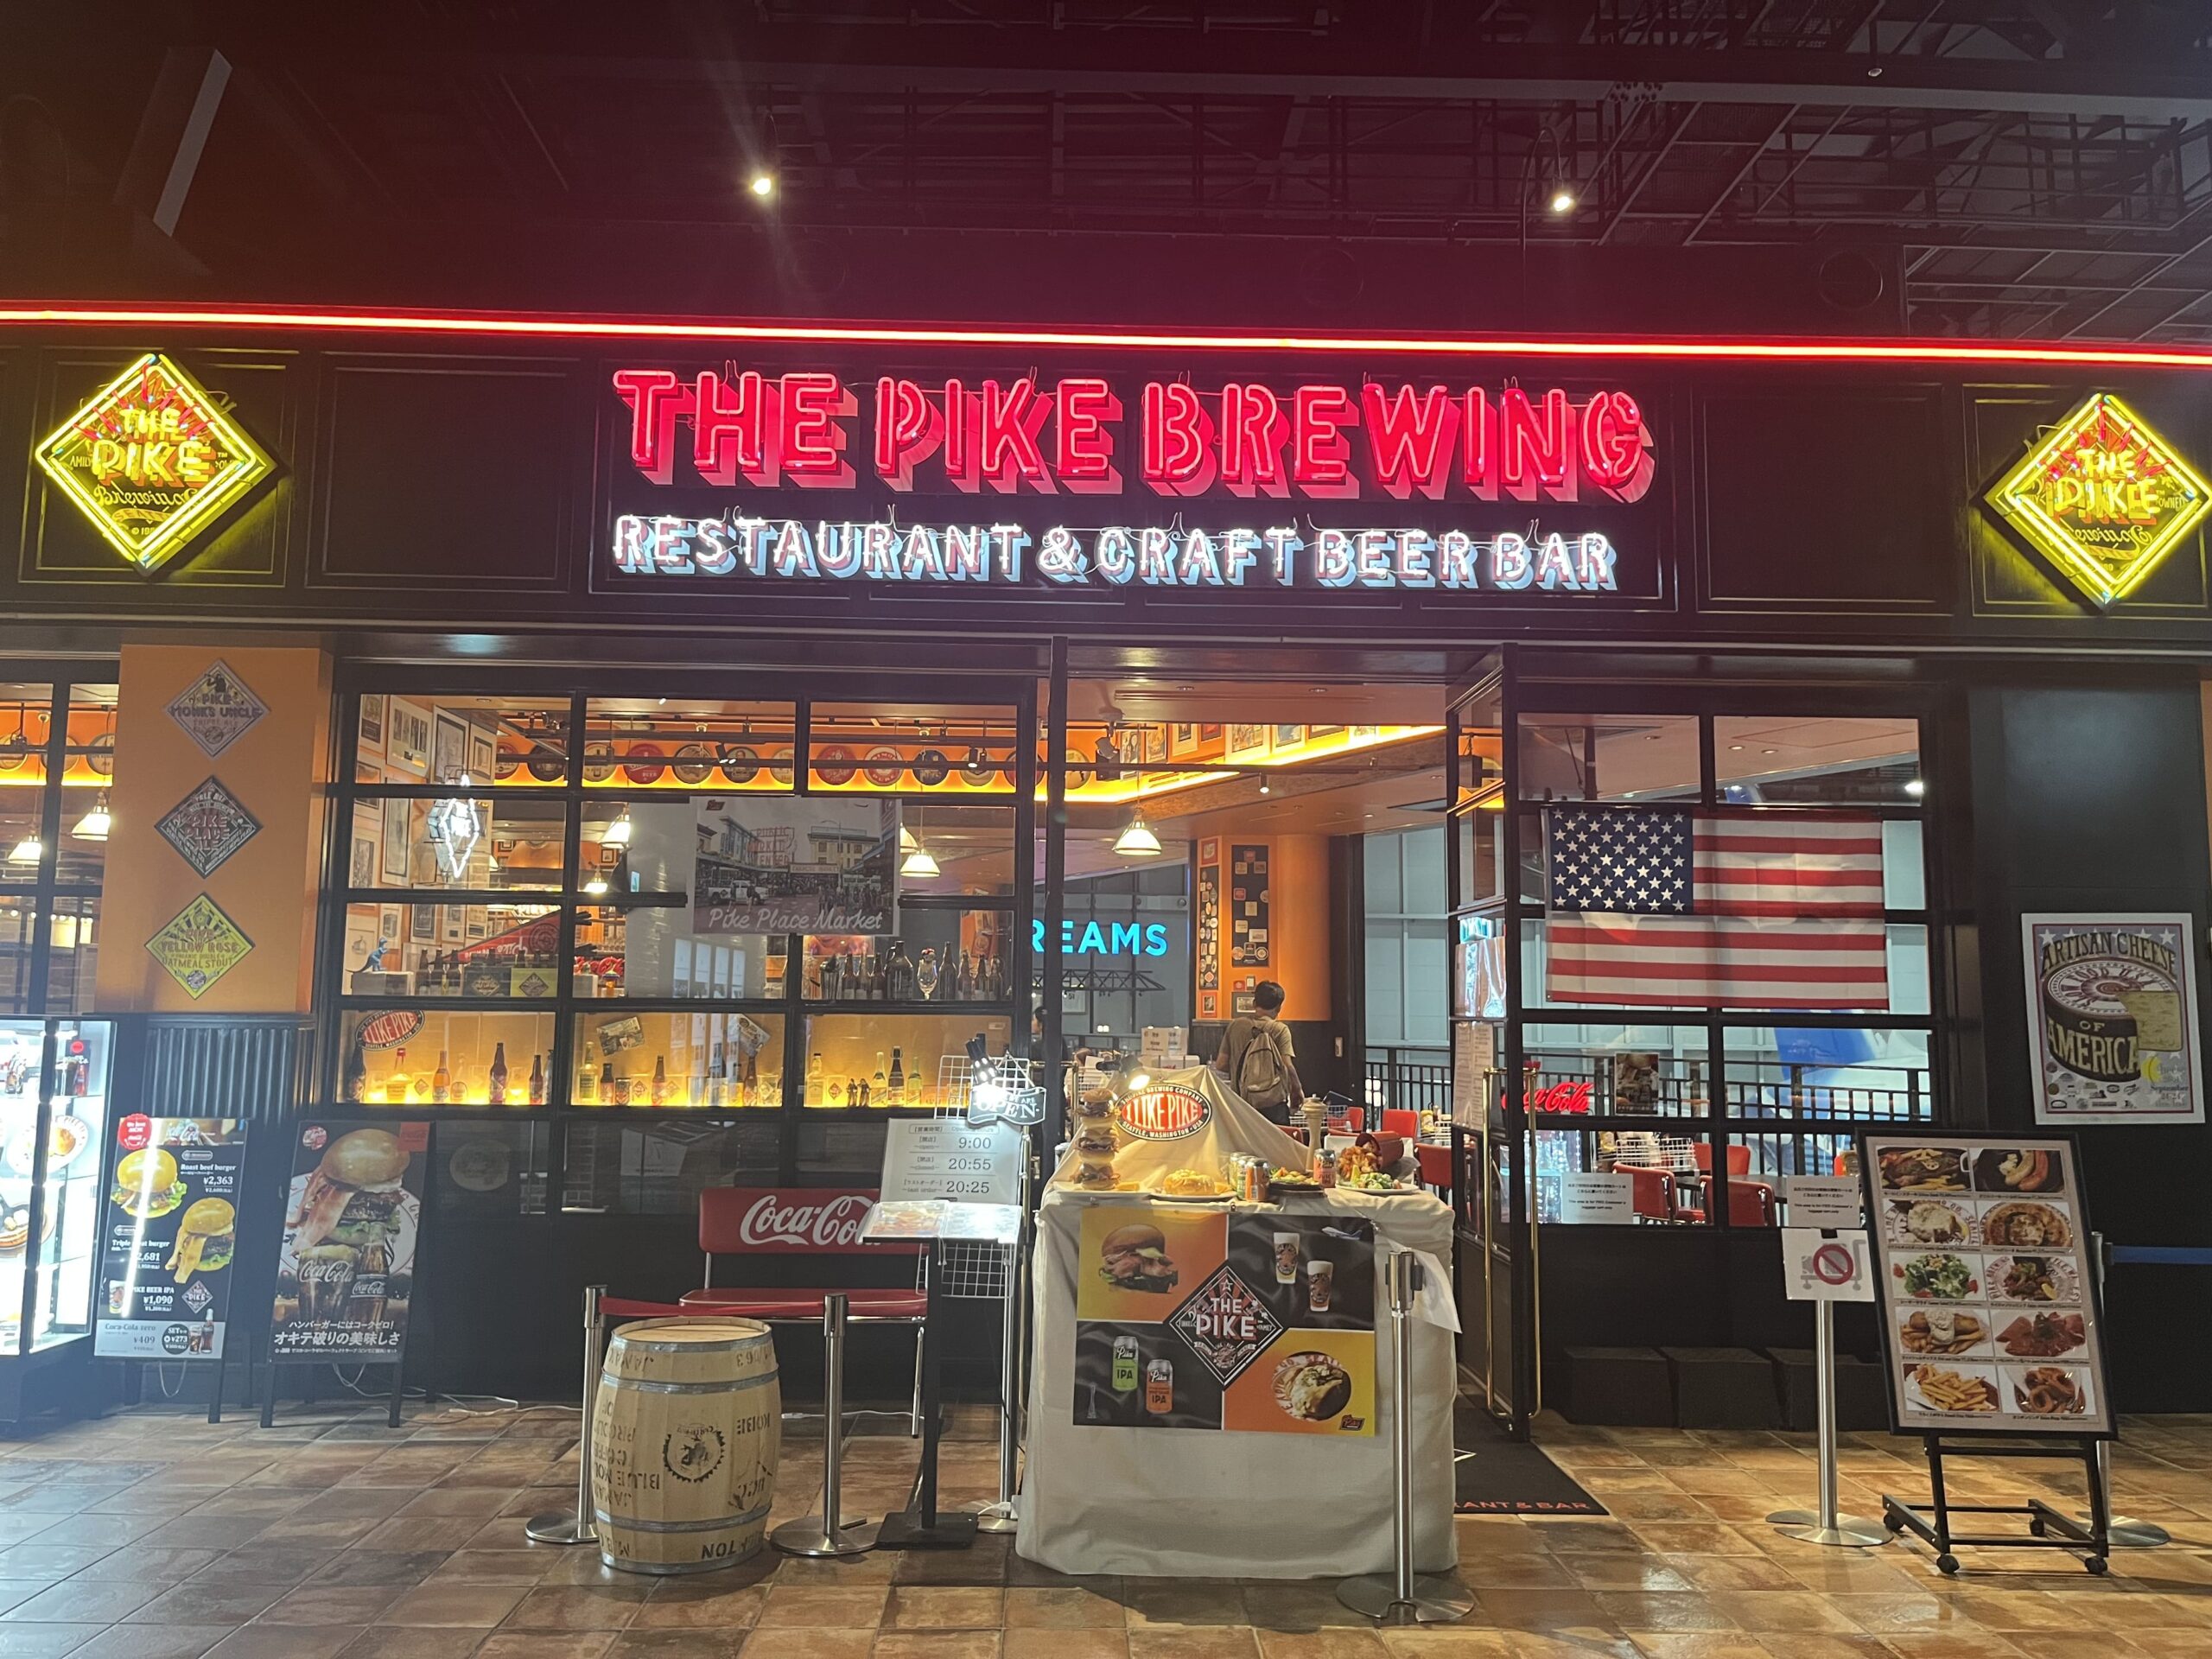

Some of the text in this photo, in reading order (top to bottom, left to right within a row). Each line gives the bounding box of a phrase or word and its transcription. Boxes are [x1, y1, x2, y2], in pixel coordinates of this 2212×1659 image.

[119, 408, 186, 443] THE
[613, 370, 1656, 504] THE PIKE BREWING
[92, 440, 215, 487] PIKE
[2075, 449, 2137, 478] THE
[2045, 477, 2160, 525] PIKE
[613, 515, 1618, 591] RESTAURANT & CRAFT BEER BAR
[709, 908, 883, 930] Pike Place Market
[160, 941, 238, 954] YELLOW ROSE
[2041, 931, 2177, 980] ARTISAN CHEESE
[162, 957, 232, 969] OATMEAL STOUT
[390, 1012, 416, 1039] PIKE
[2079, 1020, 2105, 1032] OF
[2046, 1015, 2140, 1077] AMERICA
[1174, 1087, 1203, 1103] COMPANY
[1127, 1093, 1198, 1130] I LIKE PIKE
[958, 1137, 991, 1149] 9:00
[1149, 1128, 1190, 1138] WASHINGTON
[948, 1158, 991, 1170] 20:55
[946, 1180, 990, 1193] 20:25
[300, 1260, 354, 1283] Coca-Cola
[353, 1281, 386, 1295] Coca-Cola
[1210, 1297, 1243, 1313] THE
[1196, 1314, 1257, 1339] PIKE
[274, 1332, 401, 1346] オキテ破りの美味しさ
[1117, 1369, 1133, 1379] IPA
[1152, 1395, 1166, 1404] IPA
[737, 1413, 770, 1434] KOBE
[617, 1471, 659, 1490] BLUE
